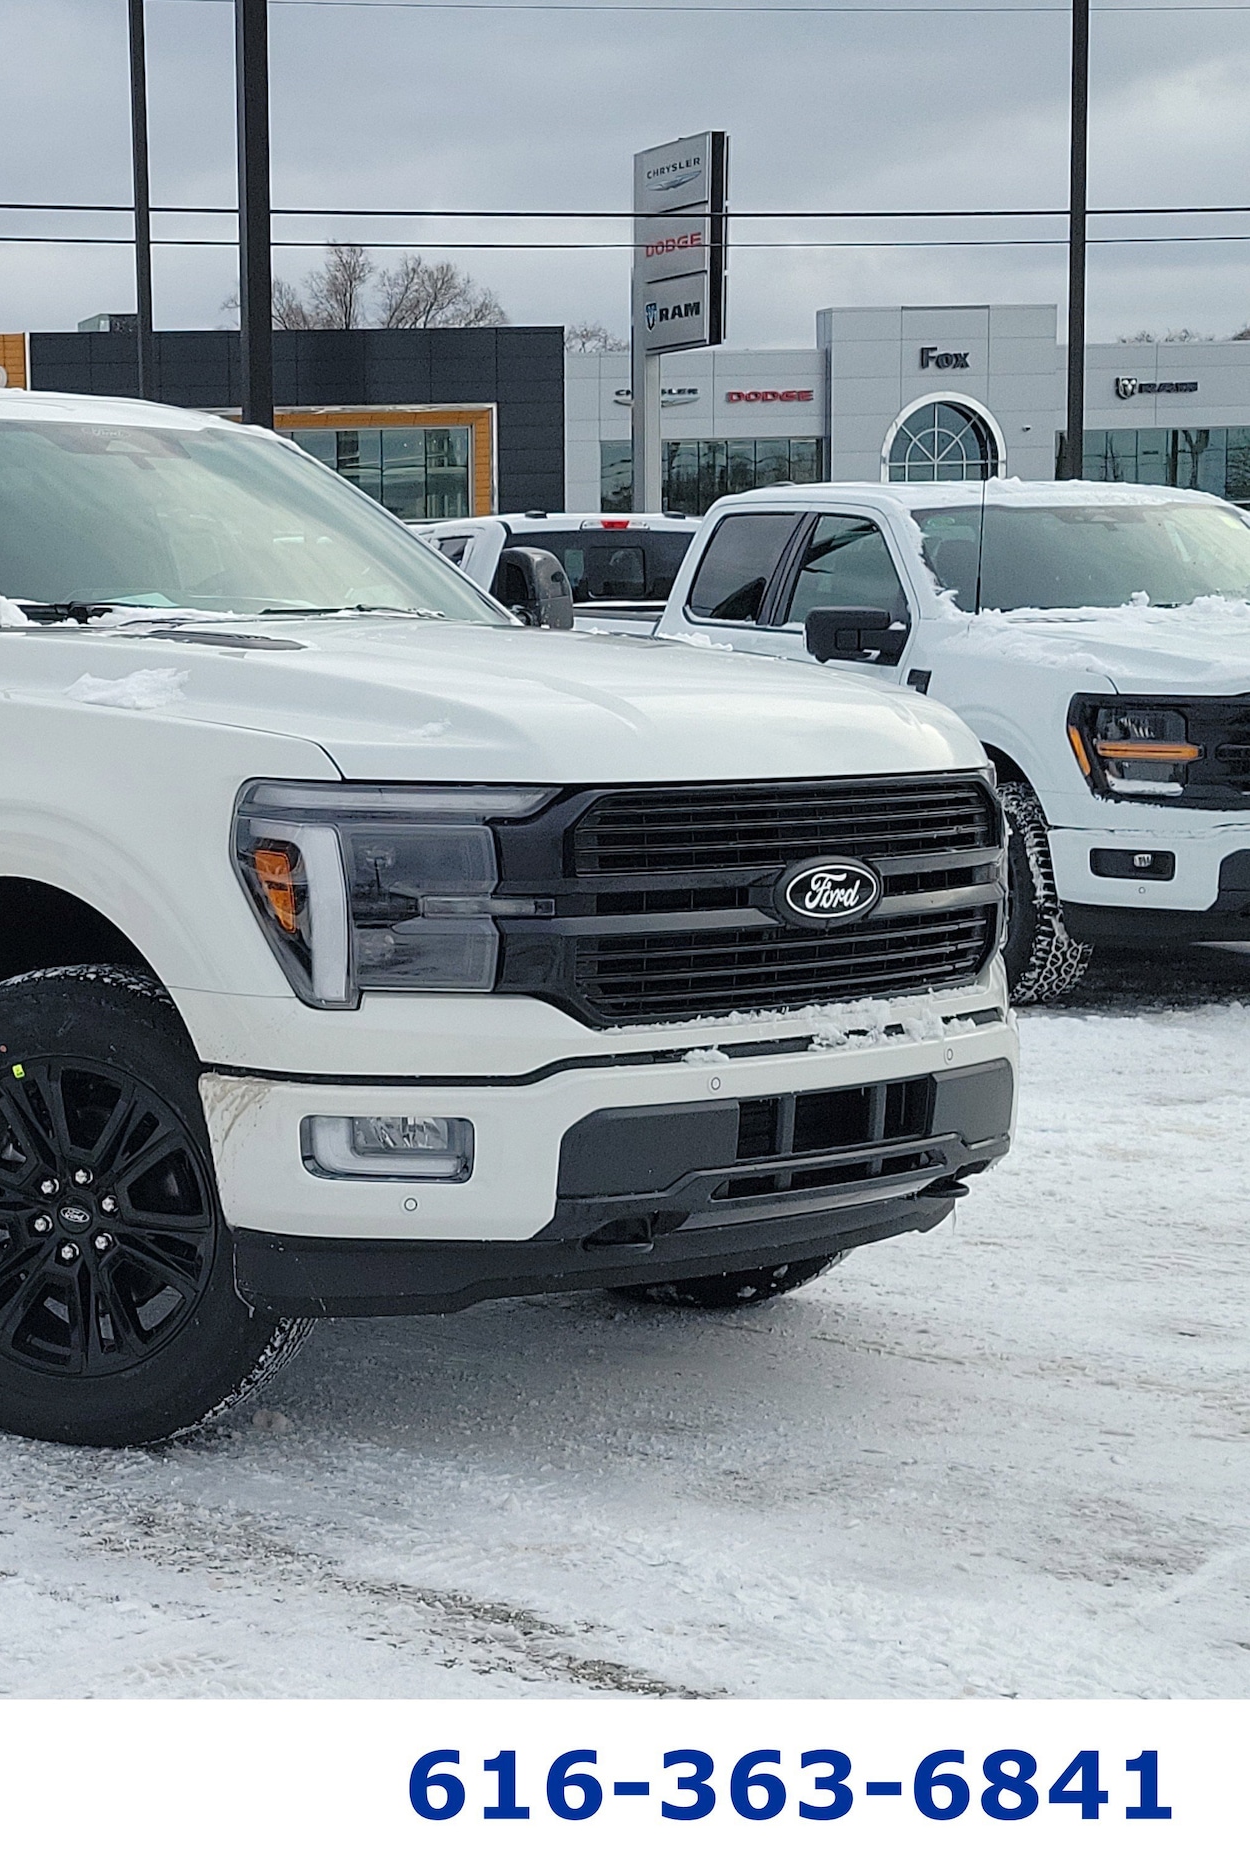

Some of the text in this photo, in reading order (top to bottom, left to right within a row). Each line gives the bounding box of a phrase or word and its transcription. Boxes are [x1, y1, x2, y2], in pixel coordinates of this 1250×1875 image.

[646, 157, 701, 179] CHRYSLER
[645, 232, 702, 258] DODGE
[659, 301, 701, 322] RAM
[919, 346, 970, 369] Fox
[726, 390, 814, 403] DODGE
[805, 873, 861, 909] Ford
